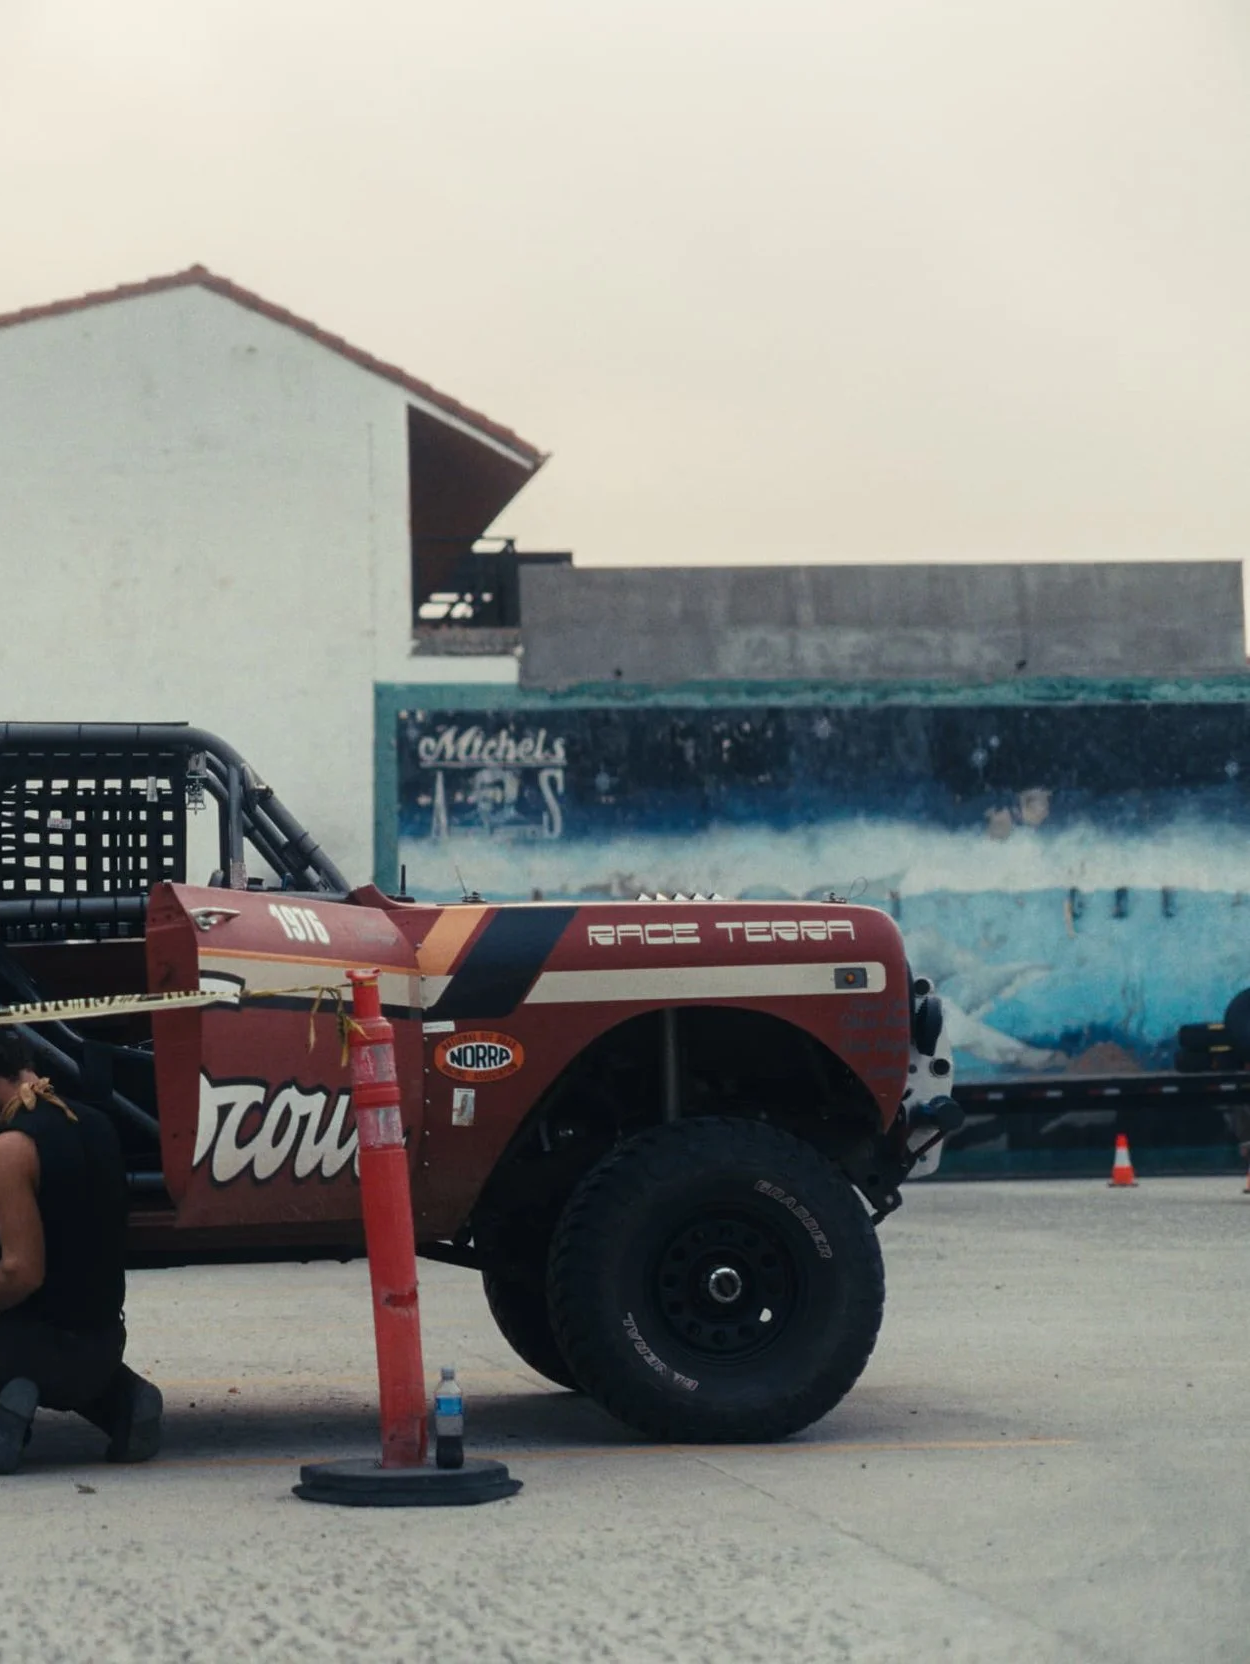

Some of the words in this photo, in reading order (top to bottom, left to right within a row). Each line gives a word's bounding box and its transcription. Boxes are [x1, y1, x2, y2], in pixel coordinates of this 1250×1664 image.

[268, 903, 331, 946] 1976
[587, 922, 701, 946] RACE
[715, 919, 855, 942] TERRA
[450, 1044, 511, 1068] NORRA
[754, 1180, 833, 1259] GRABBER
